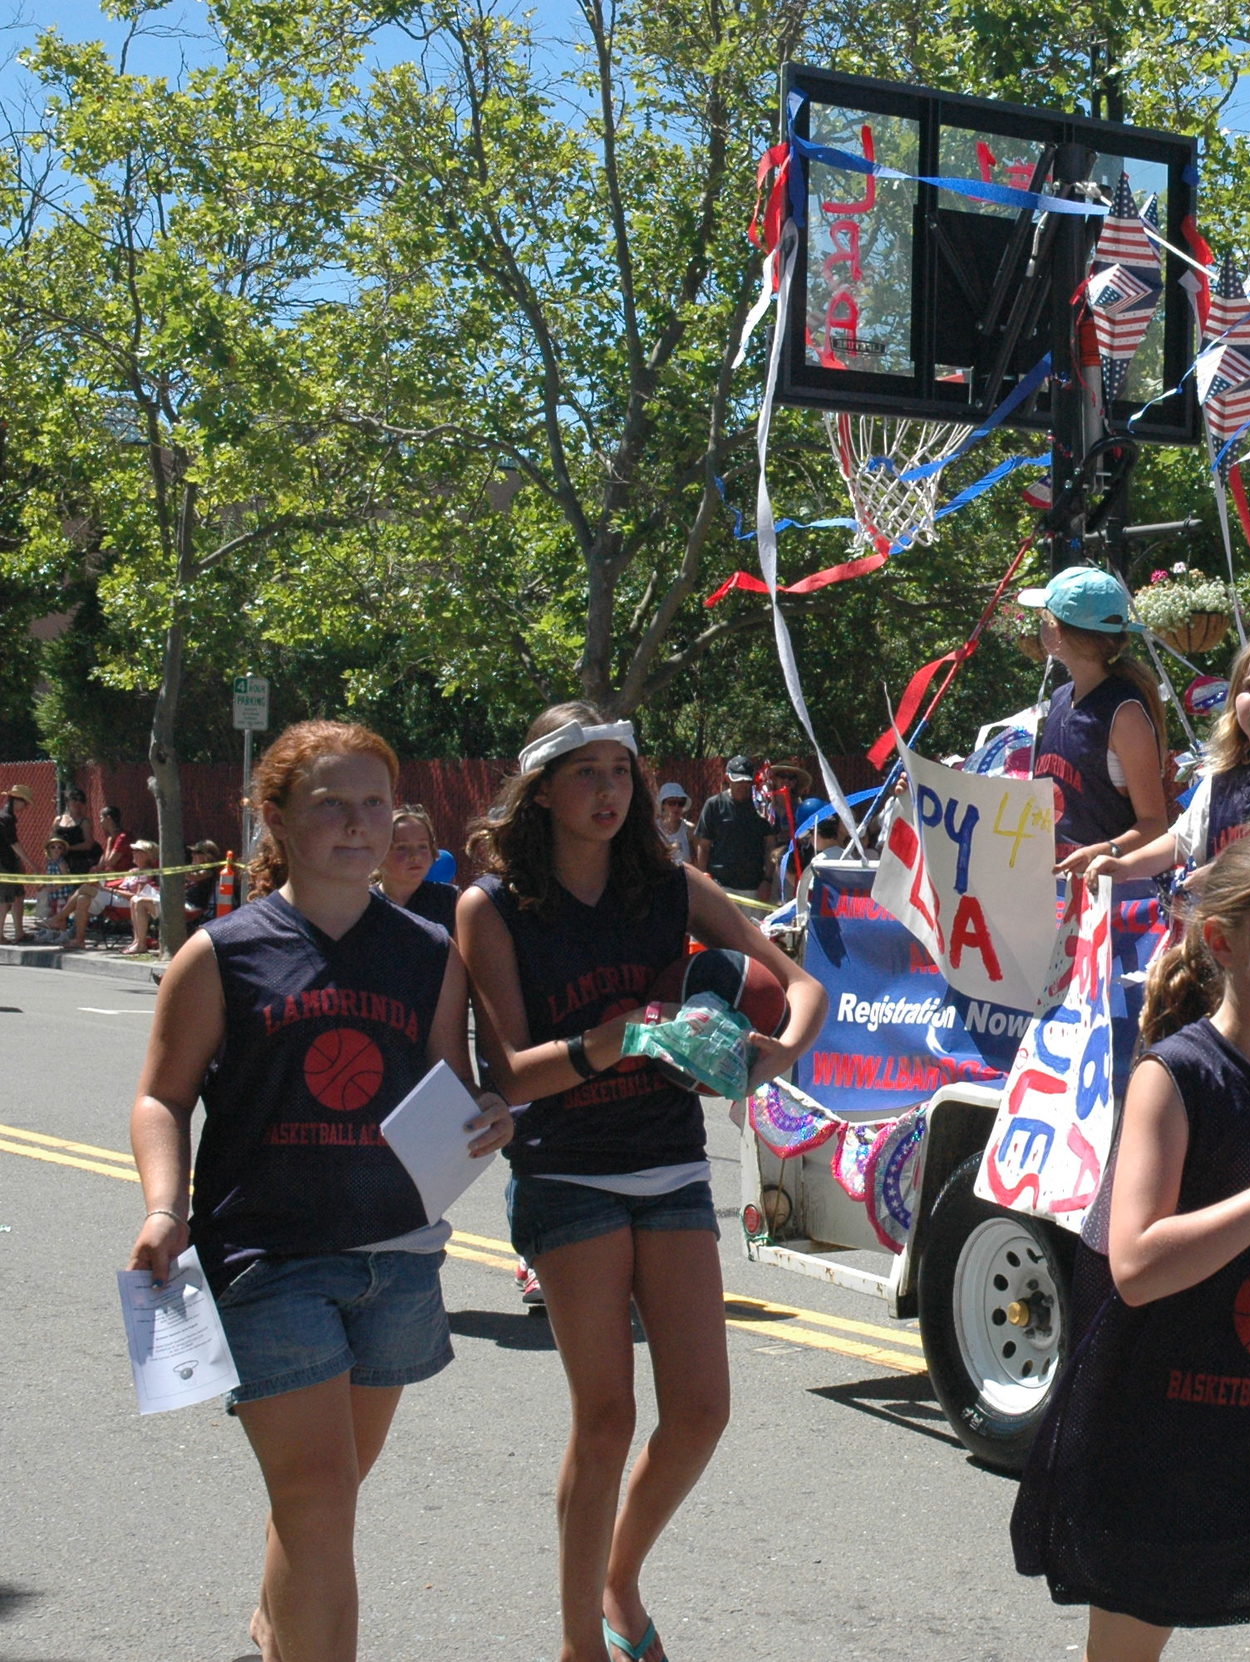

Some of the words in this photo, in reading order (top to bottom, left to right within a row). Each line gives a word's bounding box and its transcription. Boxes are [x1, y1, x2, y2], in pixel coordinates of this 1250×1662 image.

[263, 987, 419, 1044] LAMORINDA
[837, 992, 957, 1032] Registration
[964, 1000, 1034, 1039] Now
